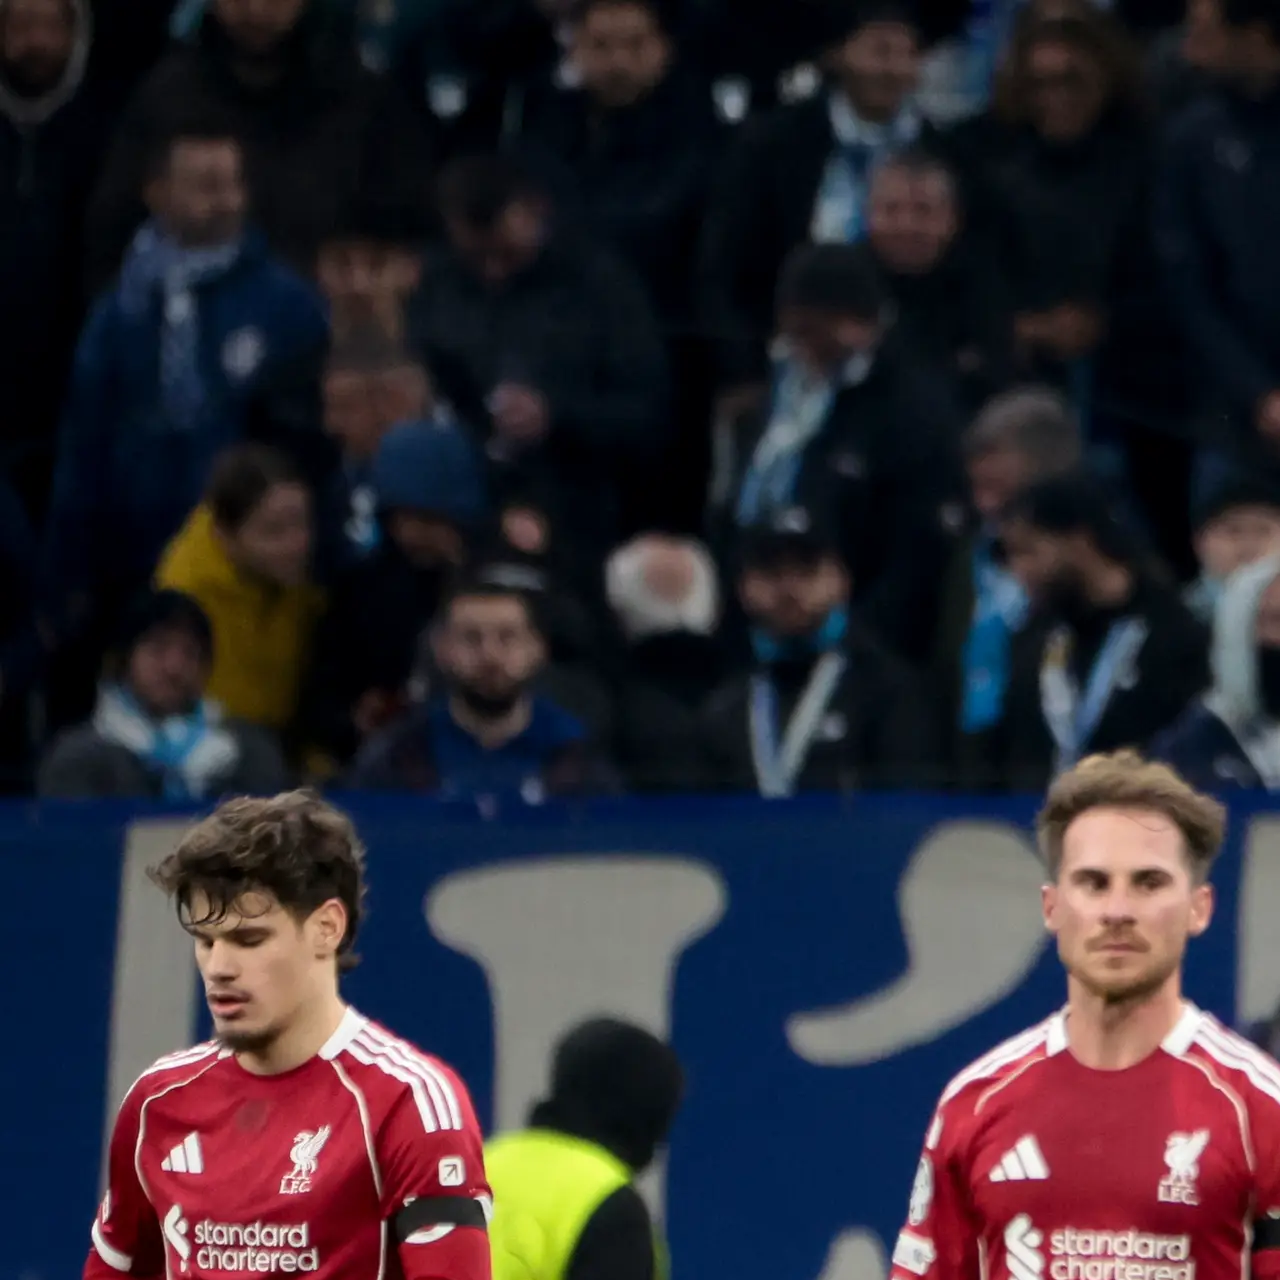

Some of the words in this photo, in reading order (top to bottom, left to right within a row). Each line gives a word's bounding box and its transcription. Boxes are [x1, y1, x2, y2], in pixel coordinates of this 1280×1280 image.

[194, 1220, 308, 1249] standard
[1050, 1227, 1191, 1262] standard
[196, 1246, 319, 1273] chartered
